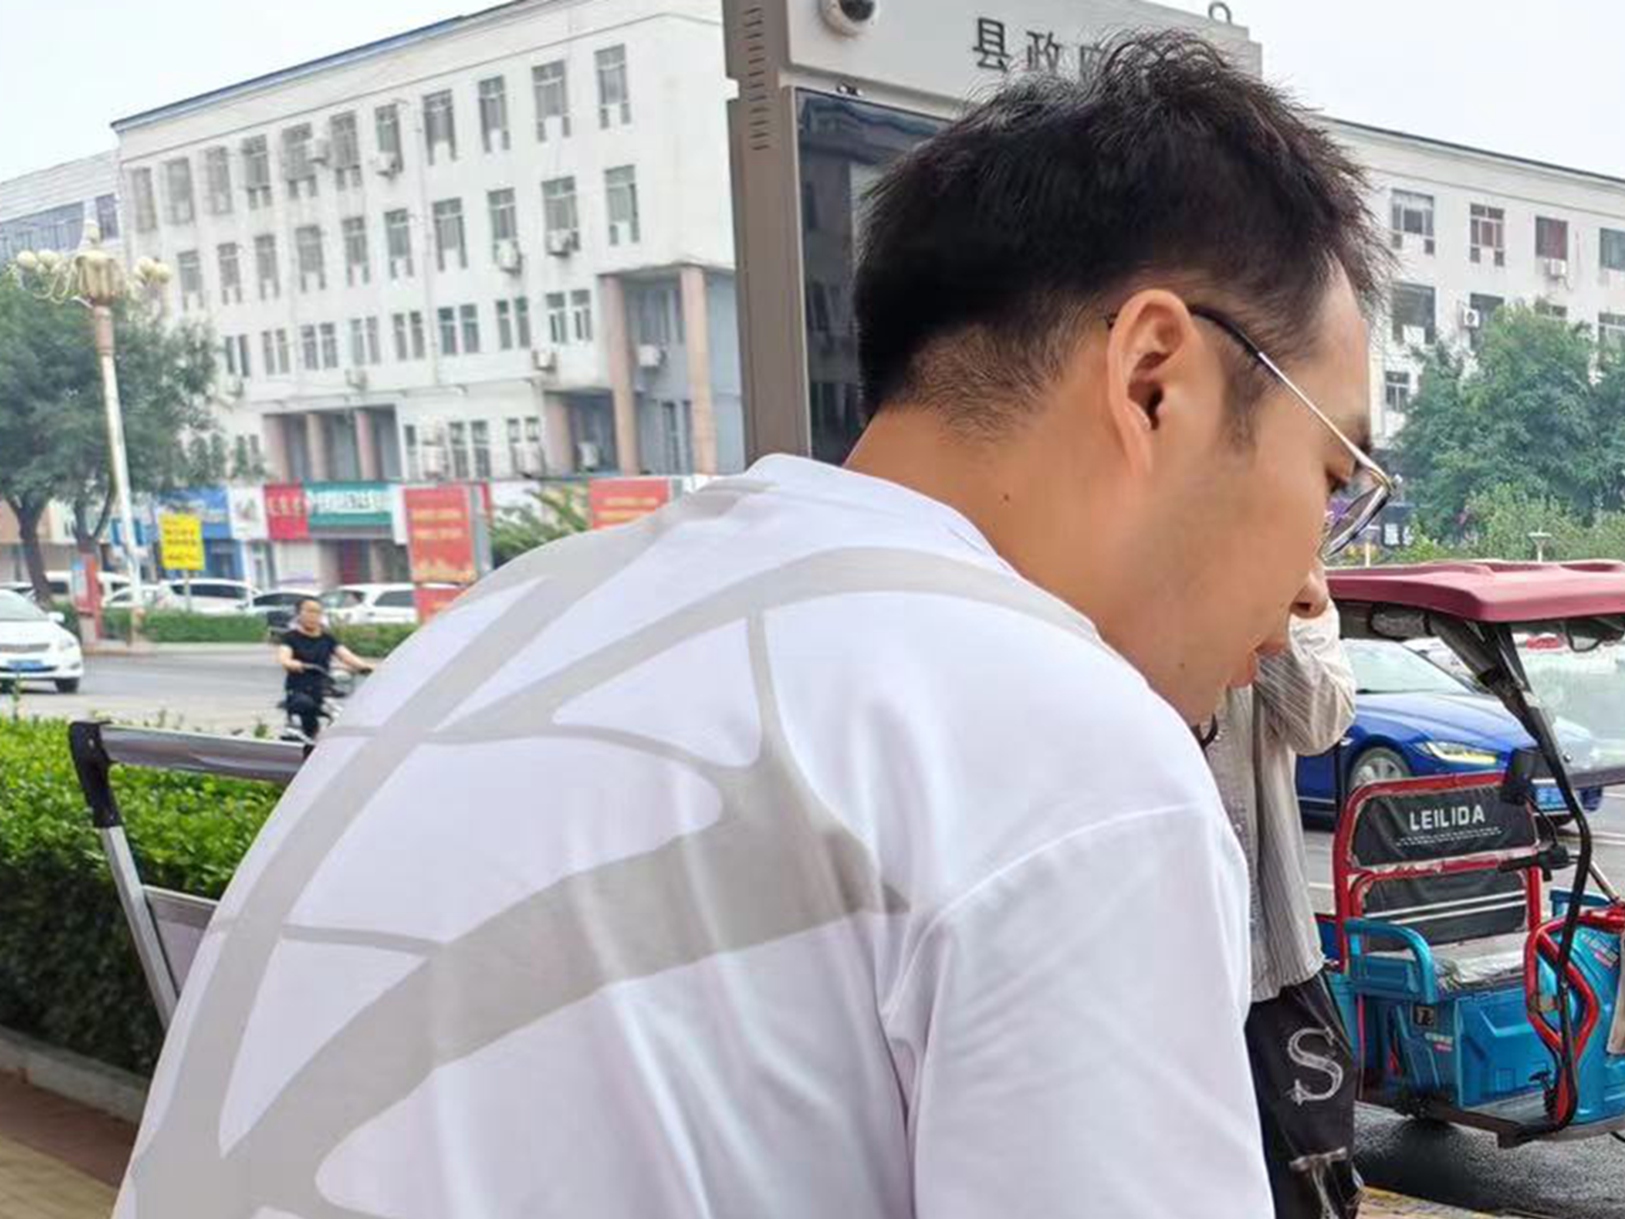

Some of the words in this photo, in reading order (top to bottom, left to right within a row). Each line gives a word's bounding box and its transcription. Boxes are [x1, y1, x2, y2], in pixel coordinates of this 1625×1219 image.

[972, 17, 1102, 76] 县政
[1410, 804, 1485, 831] LEILIDA
[1287, 1026, 1344, 1106] S
